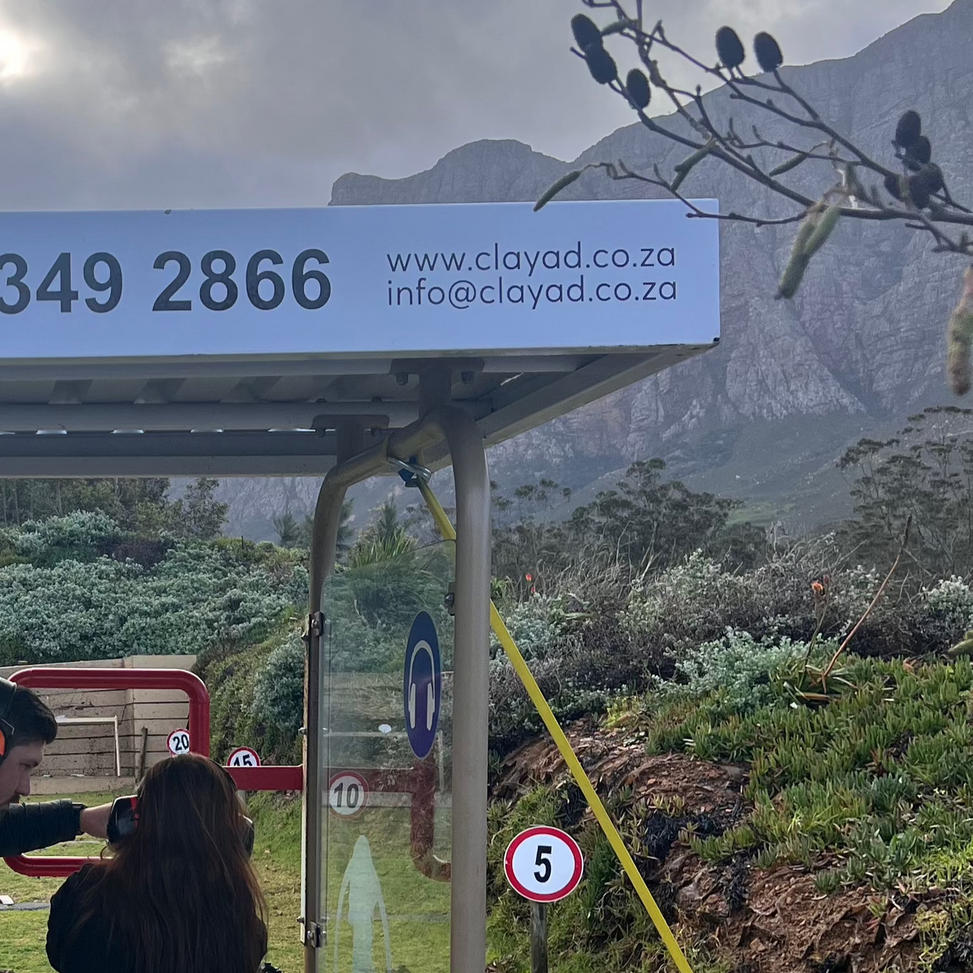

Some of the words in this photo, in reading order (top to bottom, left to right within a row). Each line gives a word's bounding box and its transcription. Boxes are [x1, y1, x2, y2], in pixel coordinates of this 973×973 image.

[386, 241, 676, 278] www.clayad.co.za
[151, 248, 332, 312] 2866
[387, 274, 677, 310] info@clayad.co.za
[172, 734, 189, 751] 20
[233, 754, 252, 766] 15
[333, 783, 358, 808] 10
[533, 845, 552, 883] 5
